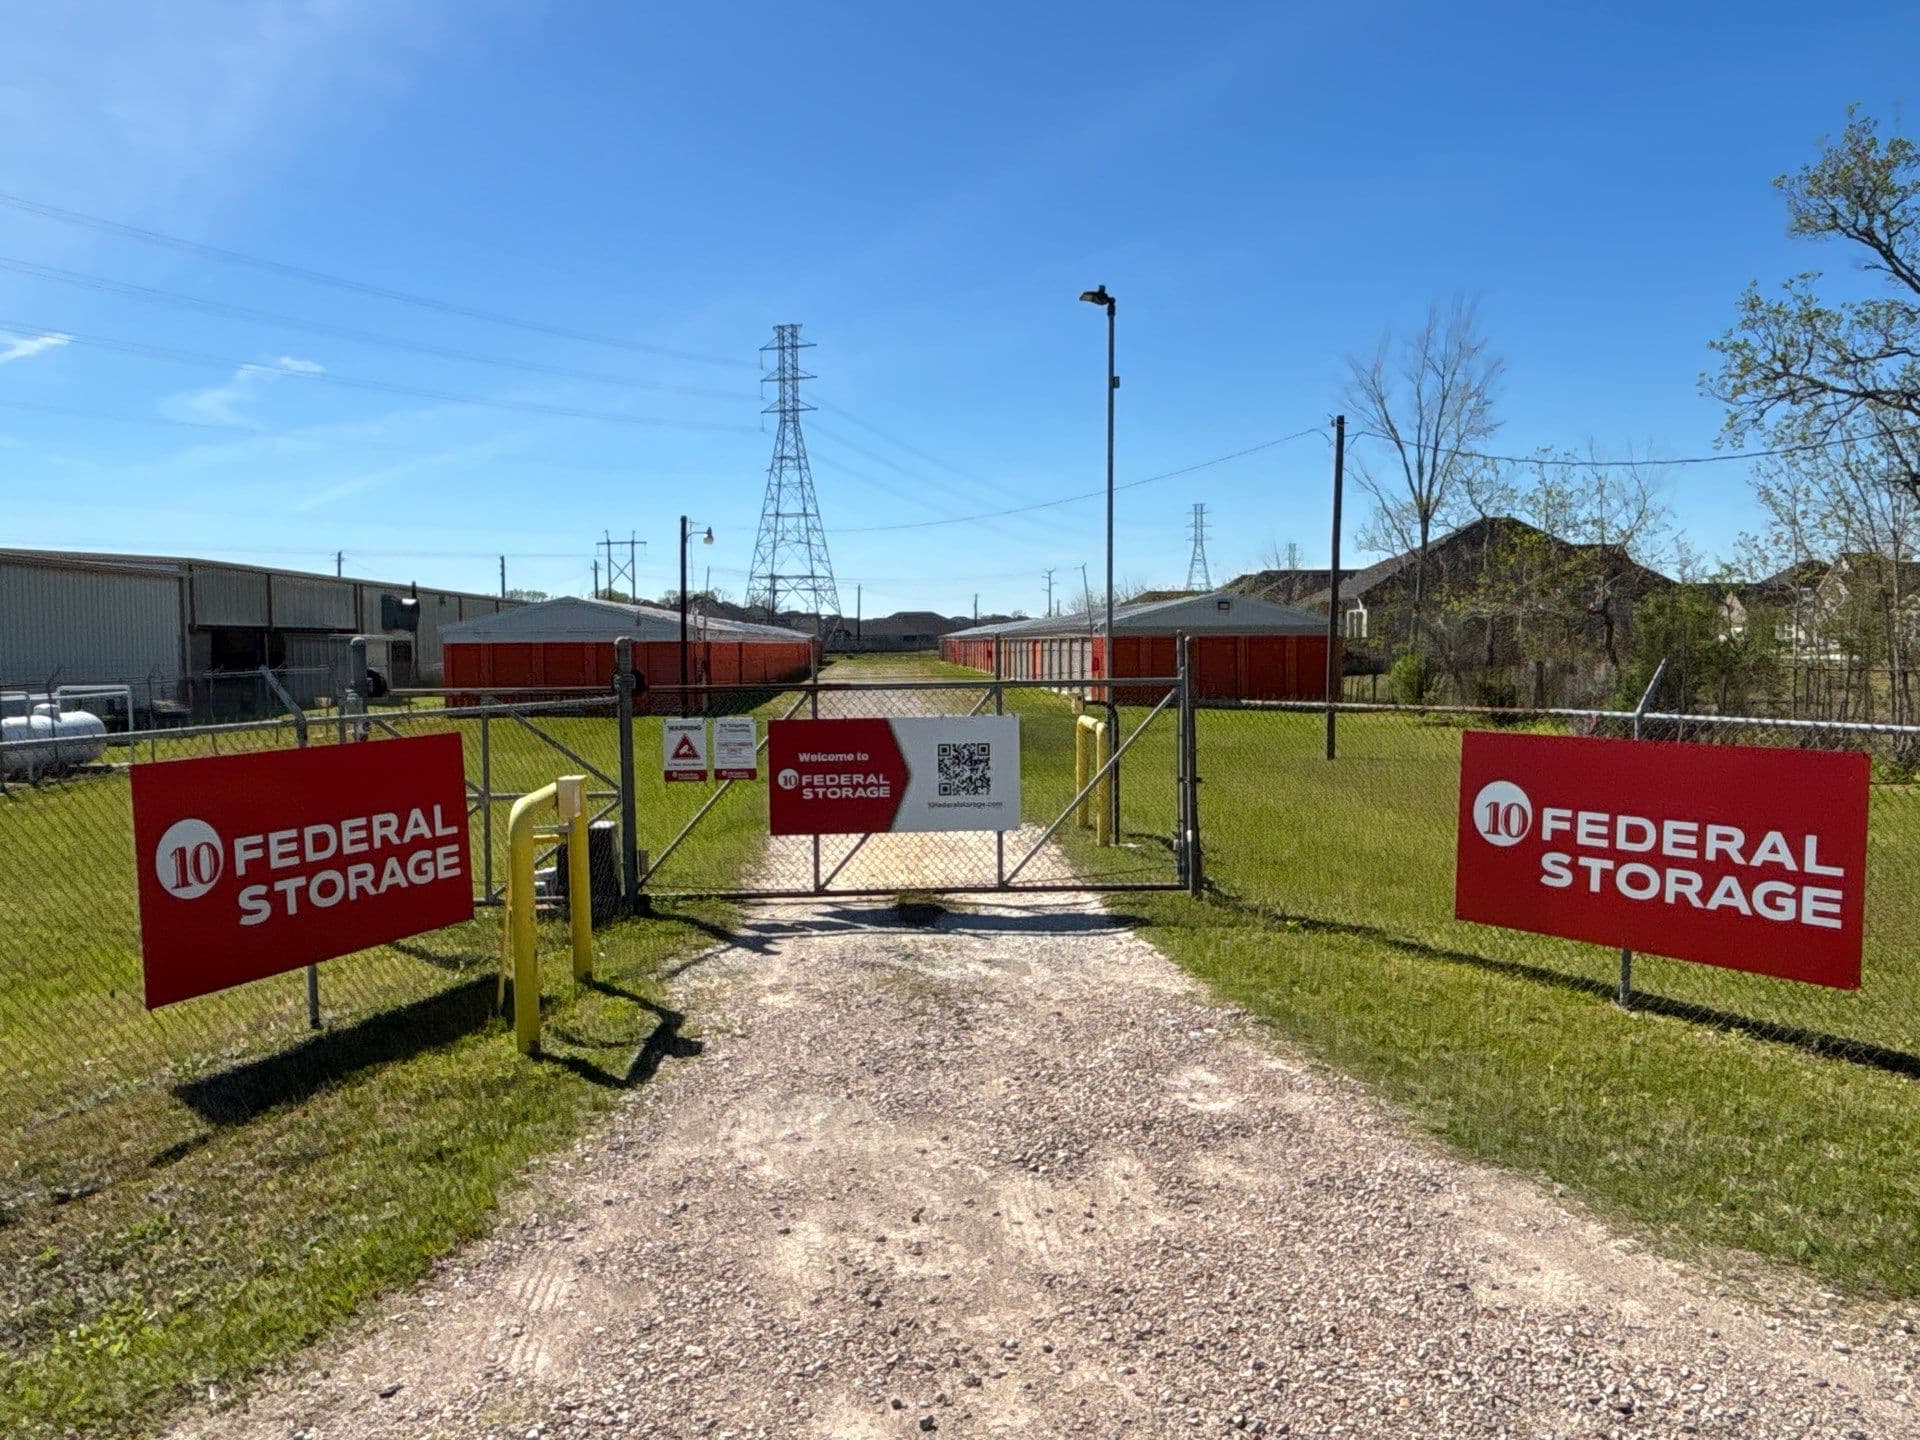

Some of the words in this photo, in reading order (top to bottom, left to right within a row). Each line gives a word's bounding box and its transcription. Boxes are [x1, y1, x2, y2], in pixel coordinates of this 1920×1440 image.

[782, 774, 798, 787] 10
[801, 774, 890, 786] FEDERAL
[798, 752, 855, 763] Welcome
[856, 752, 869, 762] to
[802, 787, 891, 800] STORAGE
[169, 841, 221, 890] 10
[233, 804, 459, 876] FEDERAL
[1483, 801, 1530, 839] 10
[1541, 807, 1845, 878] FEDERAL
[238, 844, 462, 926] STORAGE
[1540, 852, 1843, 930] STORAGE
